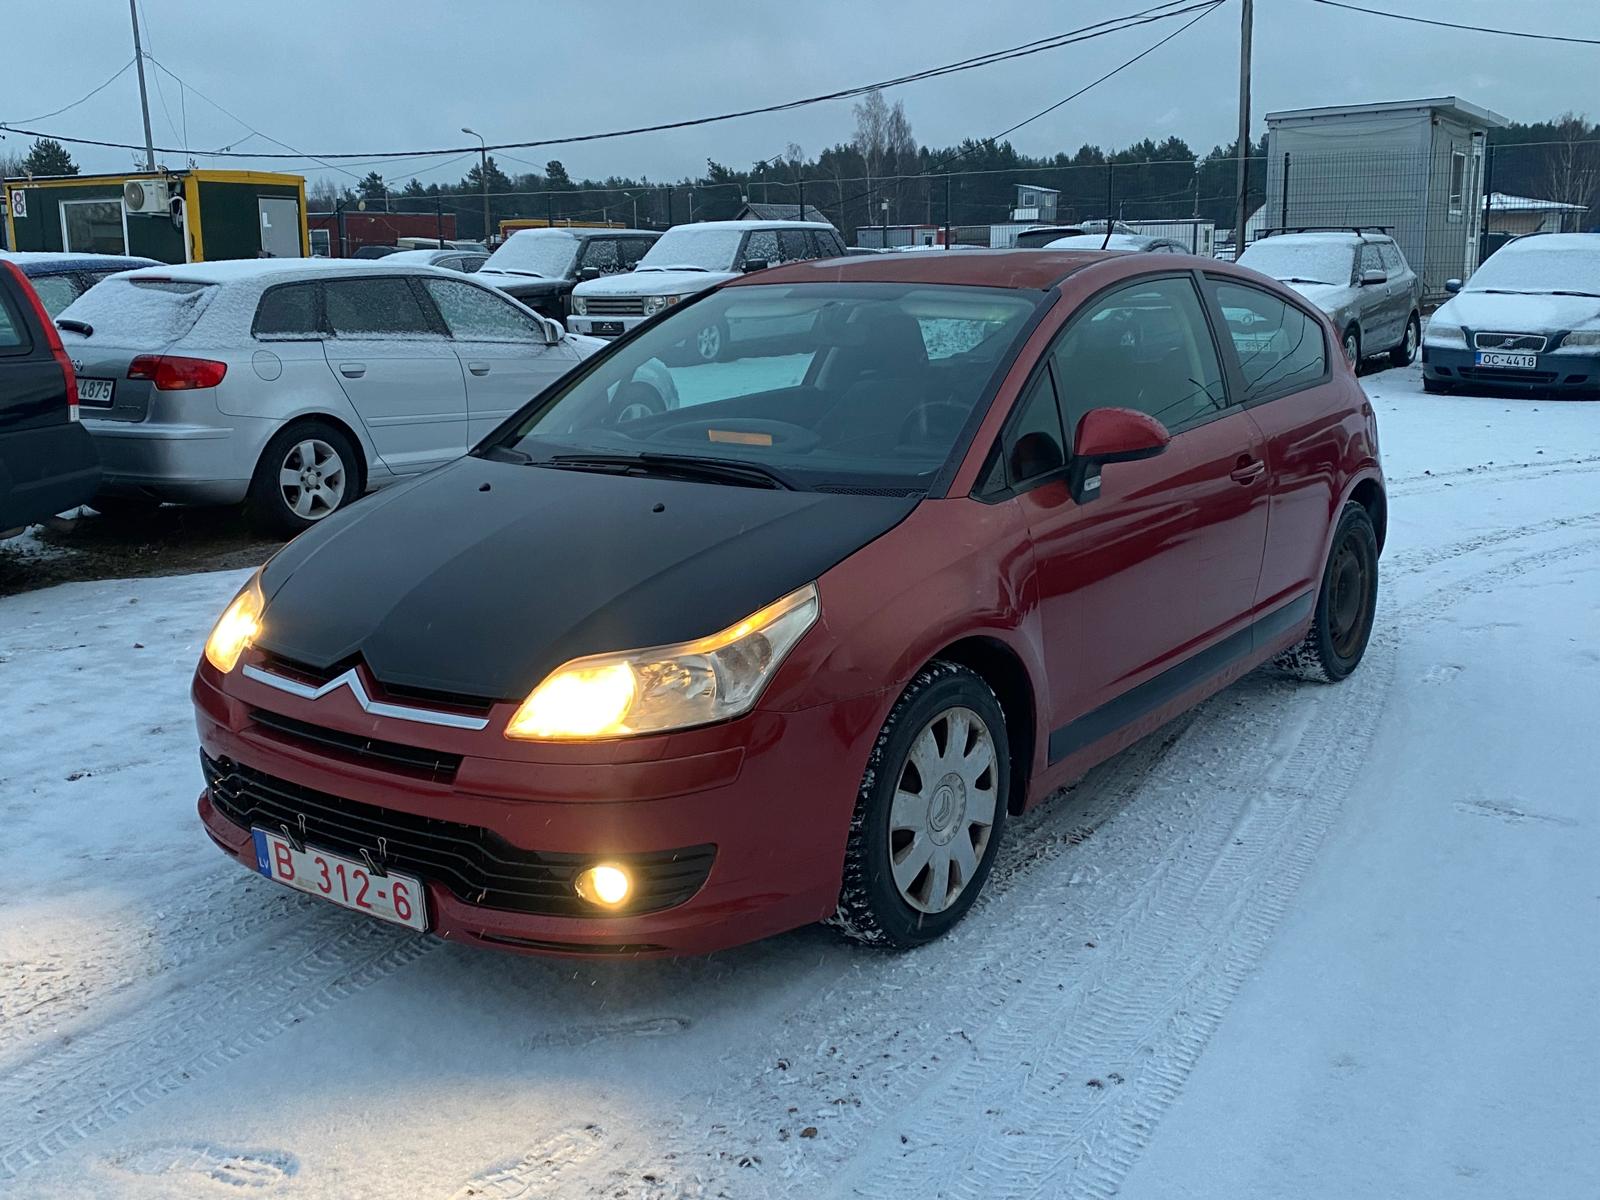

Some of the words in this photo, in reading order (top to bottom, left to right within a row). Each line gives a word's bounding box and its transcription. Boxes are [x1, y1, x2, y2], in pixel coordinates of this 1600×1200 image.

[1483, 354, 1534, 367] OC-4418
[258, 856, 269, 869] LV
[274, 841, 295, 881] B
[314, 856, 412, 920] 312-6
